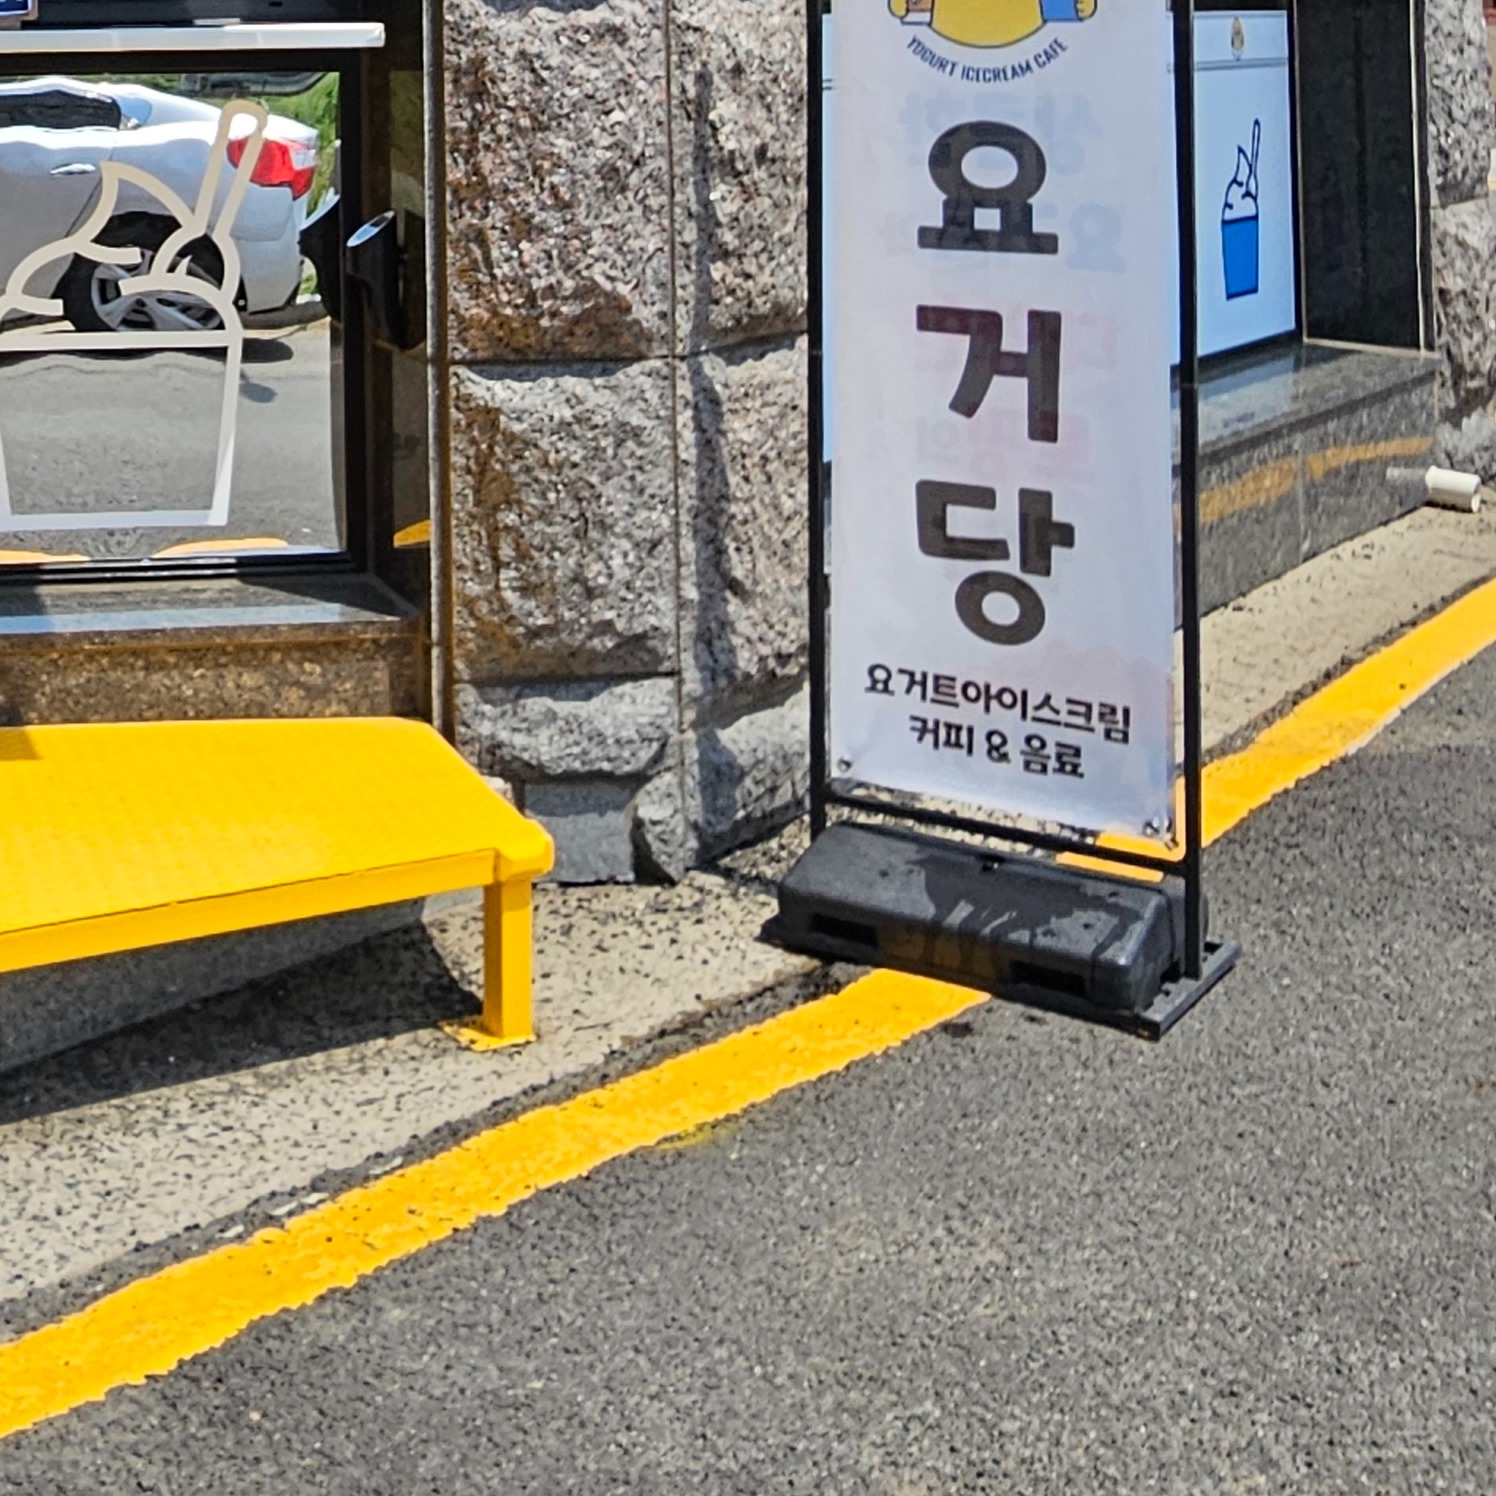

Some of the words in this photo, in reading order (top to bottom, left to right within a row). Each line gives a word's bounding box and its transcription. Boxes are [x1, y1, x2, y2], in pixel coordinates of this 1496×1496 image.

[907, 34, 959, 77] YOGURT
[961, 59, 1034, 83] ICECREAM
[1033, 37, 1069, 70] CAFE
[916, 120, 1076, 647] 요거당
[864, 663, 1131, 745] 요거트아이스크림
[909, 714, 974, 757] 커피
[985, 728, 1011, 764] &
[1019, 733, 1085, 778] 음료
